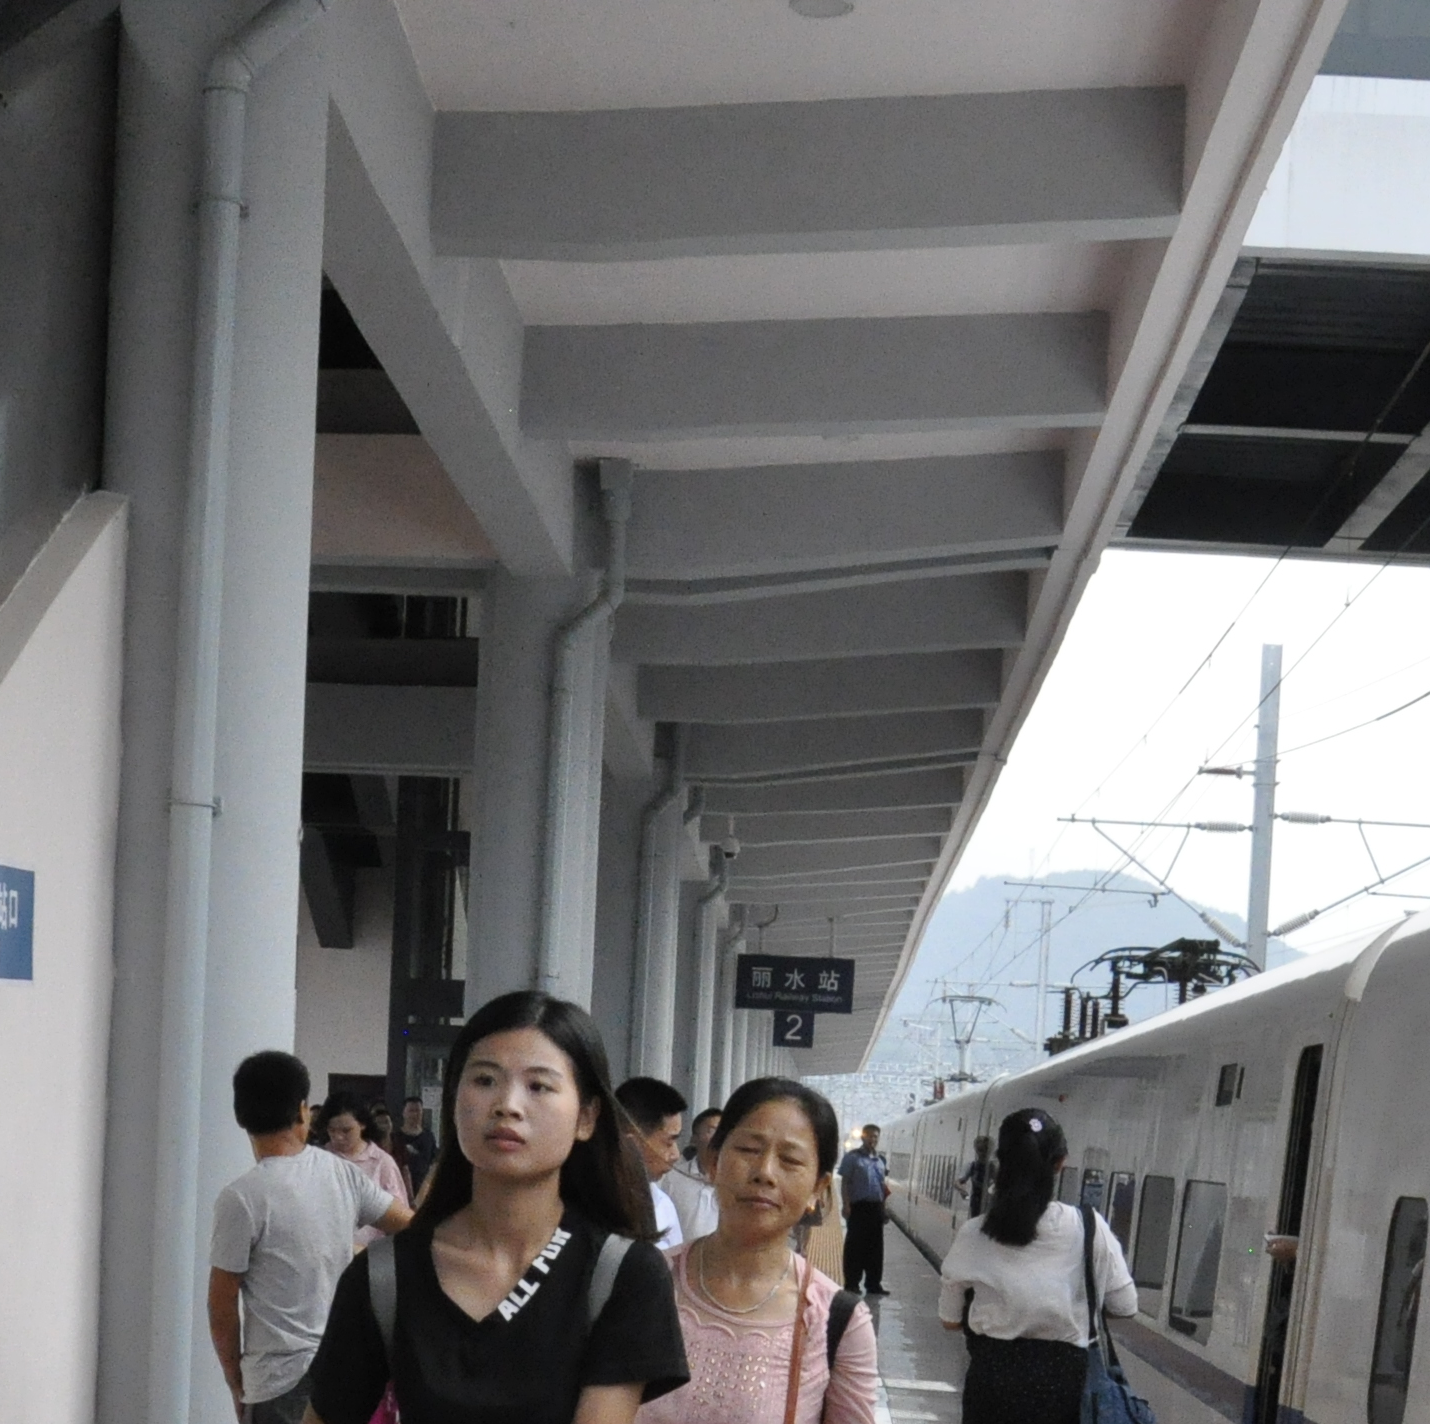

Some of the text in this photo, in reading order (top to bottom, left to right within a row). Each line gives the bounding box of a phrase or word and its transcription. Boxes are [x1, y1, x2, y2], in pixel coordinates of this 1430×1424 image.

[752, 966, 840, 992] 丽水站
[785, 1014, 803, 1040] 2
[497, 1278, 541, 1322] ALL
